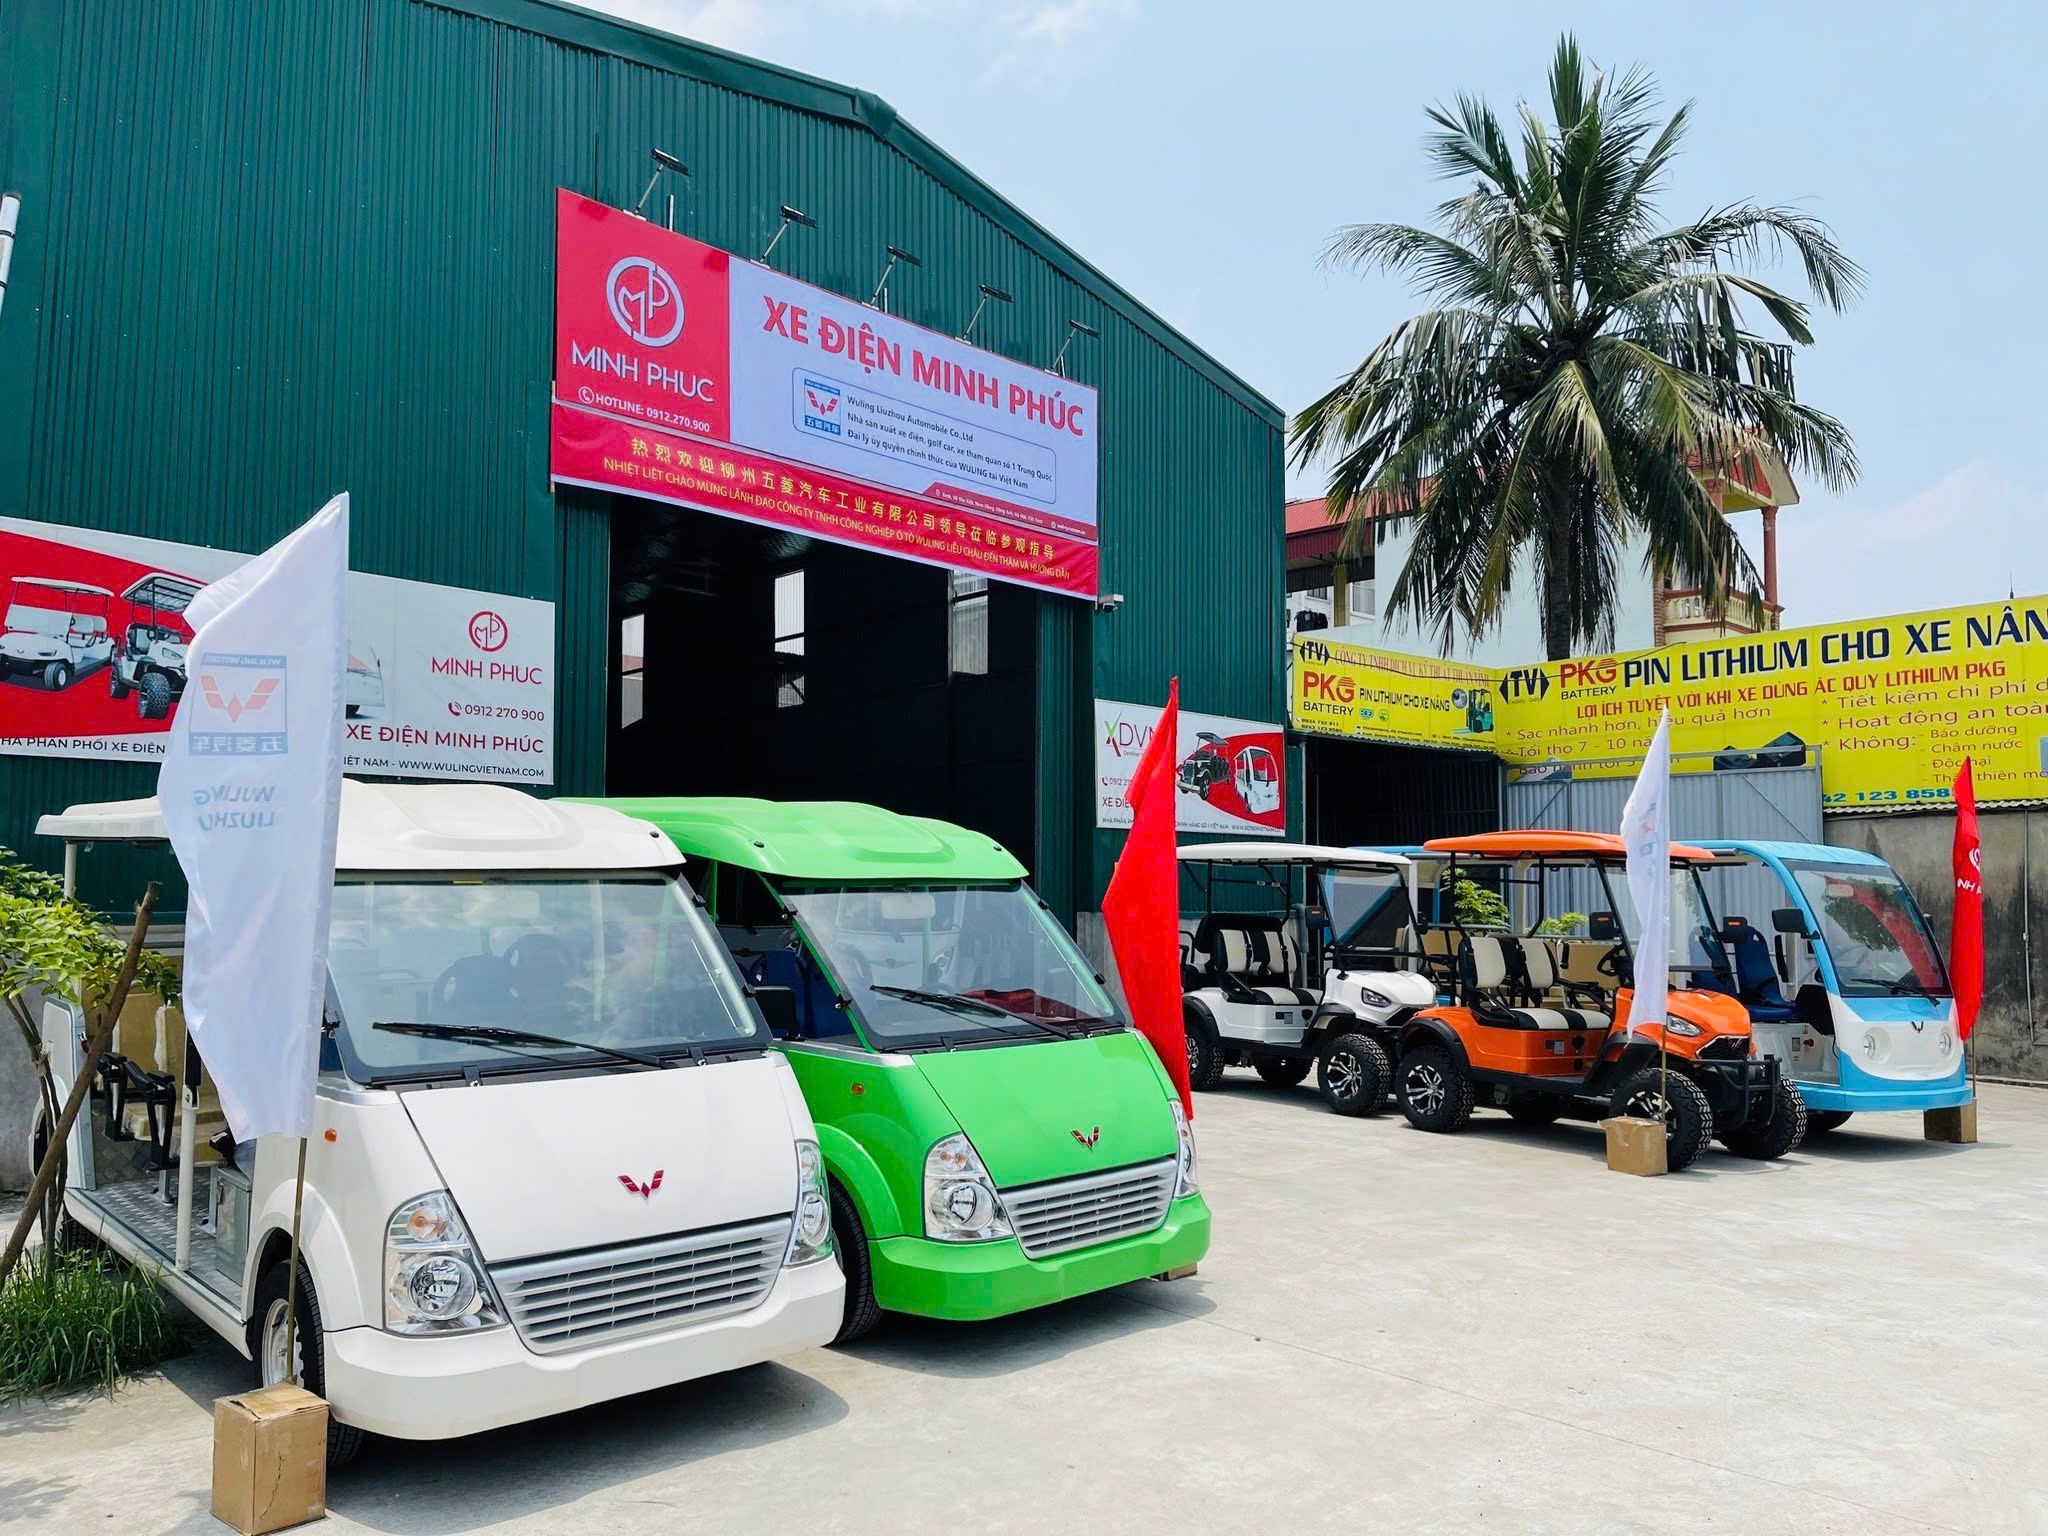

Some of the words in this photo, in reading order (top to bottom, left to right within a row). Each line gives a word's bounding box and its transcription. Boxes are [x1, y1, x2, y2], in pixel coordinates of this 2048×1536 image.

[572, 340, 638, 383] MINH
[647, 361, 714, 403] PHUC
[763, 295, 809, 344] XE
[818, 316, 900, 376] ĐIỆN
[913, 350, 998, 409] MINH
[1009, 384, 1084, 436] PHÚC
[596, 393, 644, 415] HOTLINE:
[646, 408, 710, 432] 0912.270.900
[847, 395, 874, 413] Wuling
[876, 405, 905, 420] Liuzhou
[907, 415, 948, 434] Automobile
[847, 412, 863, 424] Nhà
[927, 438, 942, 448] golf
[966, 449, 984, 461] tham
[985, 456, 1002, 467] quan
[1017, 464, 1036, 478] Trung
[959, 462, 987, 478] WULING
[1013, 479, 1029, 489] Nam
[604, 456, 639, 477] NHIỆT
[642, 466, 664, 482] LIỆT
[665, 471, 695, 489] CHÀO
[776, 499, 802, 516] CÔNG
[803, 507, 815, 519] TY
[814, 510, 839, 525] TNHH
[839, 515, 864, 532] CÔNG
[865, 523, 895, 539] NGHIỆP
[916, 535, 945, 551] WULING
[1560, 657, 1617, 688] PKG
[1624, 656, 1670, 688] PIN
[1682, 638, 1807, 681] LITHIUM
[1821, 628, 1890, 664] CHO
[1905, 620, 1951, 655] XE
[431, 656, 483, 678] MINH
[490, 662, 543, 684] PHUC
[1507, 668, 1541, 699] TV
[1706, 690, 1731, 705] KHI
[1738, 687, 1757, 702] XE
[1843, 674, 1878, 692] QUY
[1886, 665, 1958, 687] LITHIUM
[1965, 661, 2006, 679] PKG
[1304, 670, 1356, 703] PKG
[1360, 688, 1372, 701] PIN
[1374, 689, 1402, 705] LITHIUM
[1404, 694, 1419, 708] CHO
[1420, 696, 1429, 709] XE
[1561, 685, 1616, 700] BATTERY
[1837, 693, 1876, 708] Tiết
[1885, 690, 1938, 704] kiệm
[1947, 684, 1979, 699] chi
[1990, 679, 2026, 699] phí
[464, 704, 493, 717] 0912
[495, 707, 518, 719] 270
[521, 709, 545, 721] 900
[1303, 701, 1354, 716] BATTERY
[1550, 723, 1598, 737] nhanh
[1733, 706, 1771, 719] hơn
[1838, 715, 1890, 730] Hoạt
[1898, 710, 1958, 725] động
[1967, 708, 1995, 720] an
[2005, 701, 2048, 717] toà
[112, 742, 128, 751] XE
[346, 723, 372, 740] XE
[378, 725, 428, 747] ĐIỆN
[435, 731, 486, 749] MINH
[493, 735, 544, 753] PHÚC
[1579, 741, 1587, 752] 7
[1608, 738, 1626, 749] 10
[1633, 736, 1652, 747] nă
[1839, 735, 1916, 751] Không:
[344, 754, 360, 766] IỆT
[363, 757, 389, 767] NAM
[399, 760, 544, 777] WWW.WULINGVIETNAM.COM
[1977, 770, 2017, 781] thiện
[1102, 797, 1113, 807] XE
[1855, 791, 1897, 801] 123
[1905, 788, 1952, 799] 858
